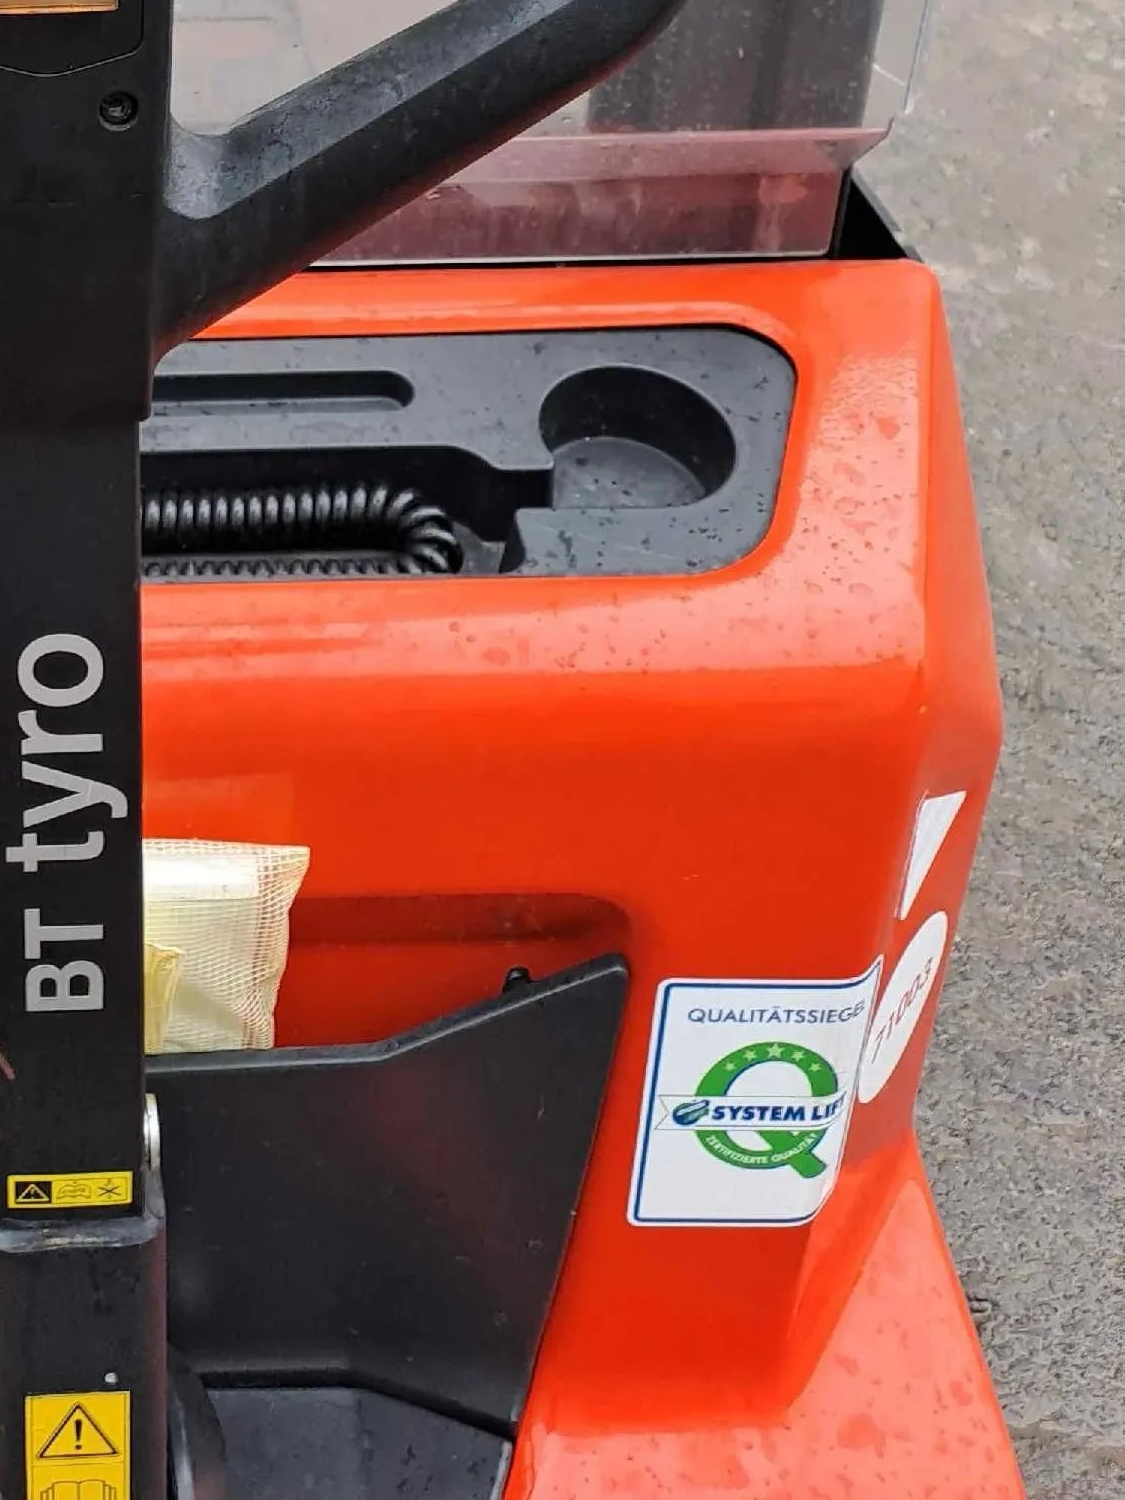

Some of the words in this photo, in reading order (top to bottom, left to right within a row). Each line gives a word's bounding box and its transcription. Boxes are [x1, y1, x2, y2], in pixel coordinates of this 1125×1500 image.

[5, 633, 129, 873] tyro
[24, 908, 105, 1012] BT
[711, 1105, 806, 1122] SYSTEM
